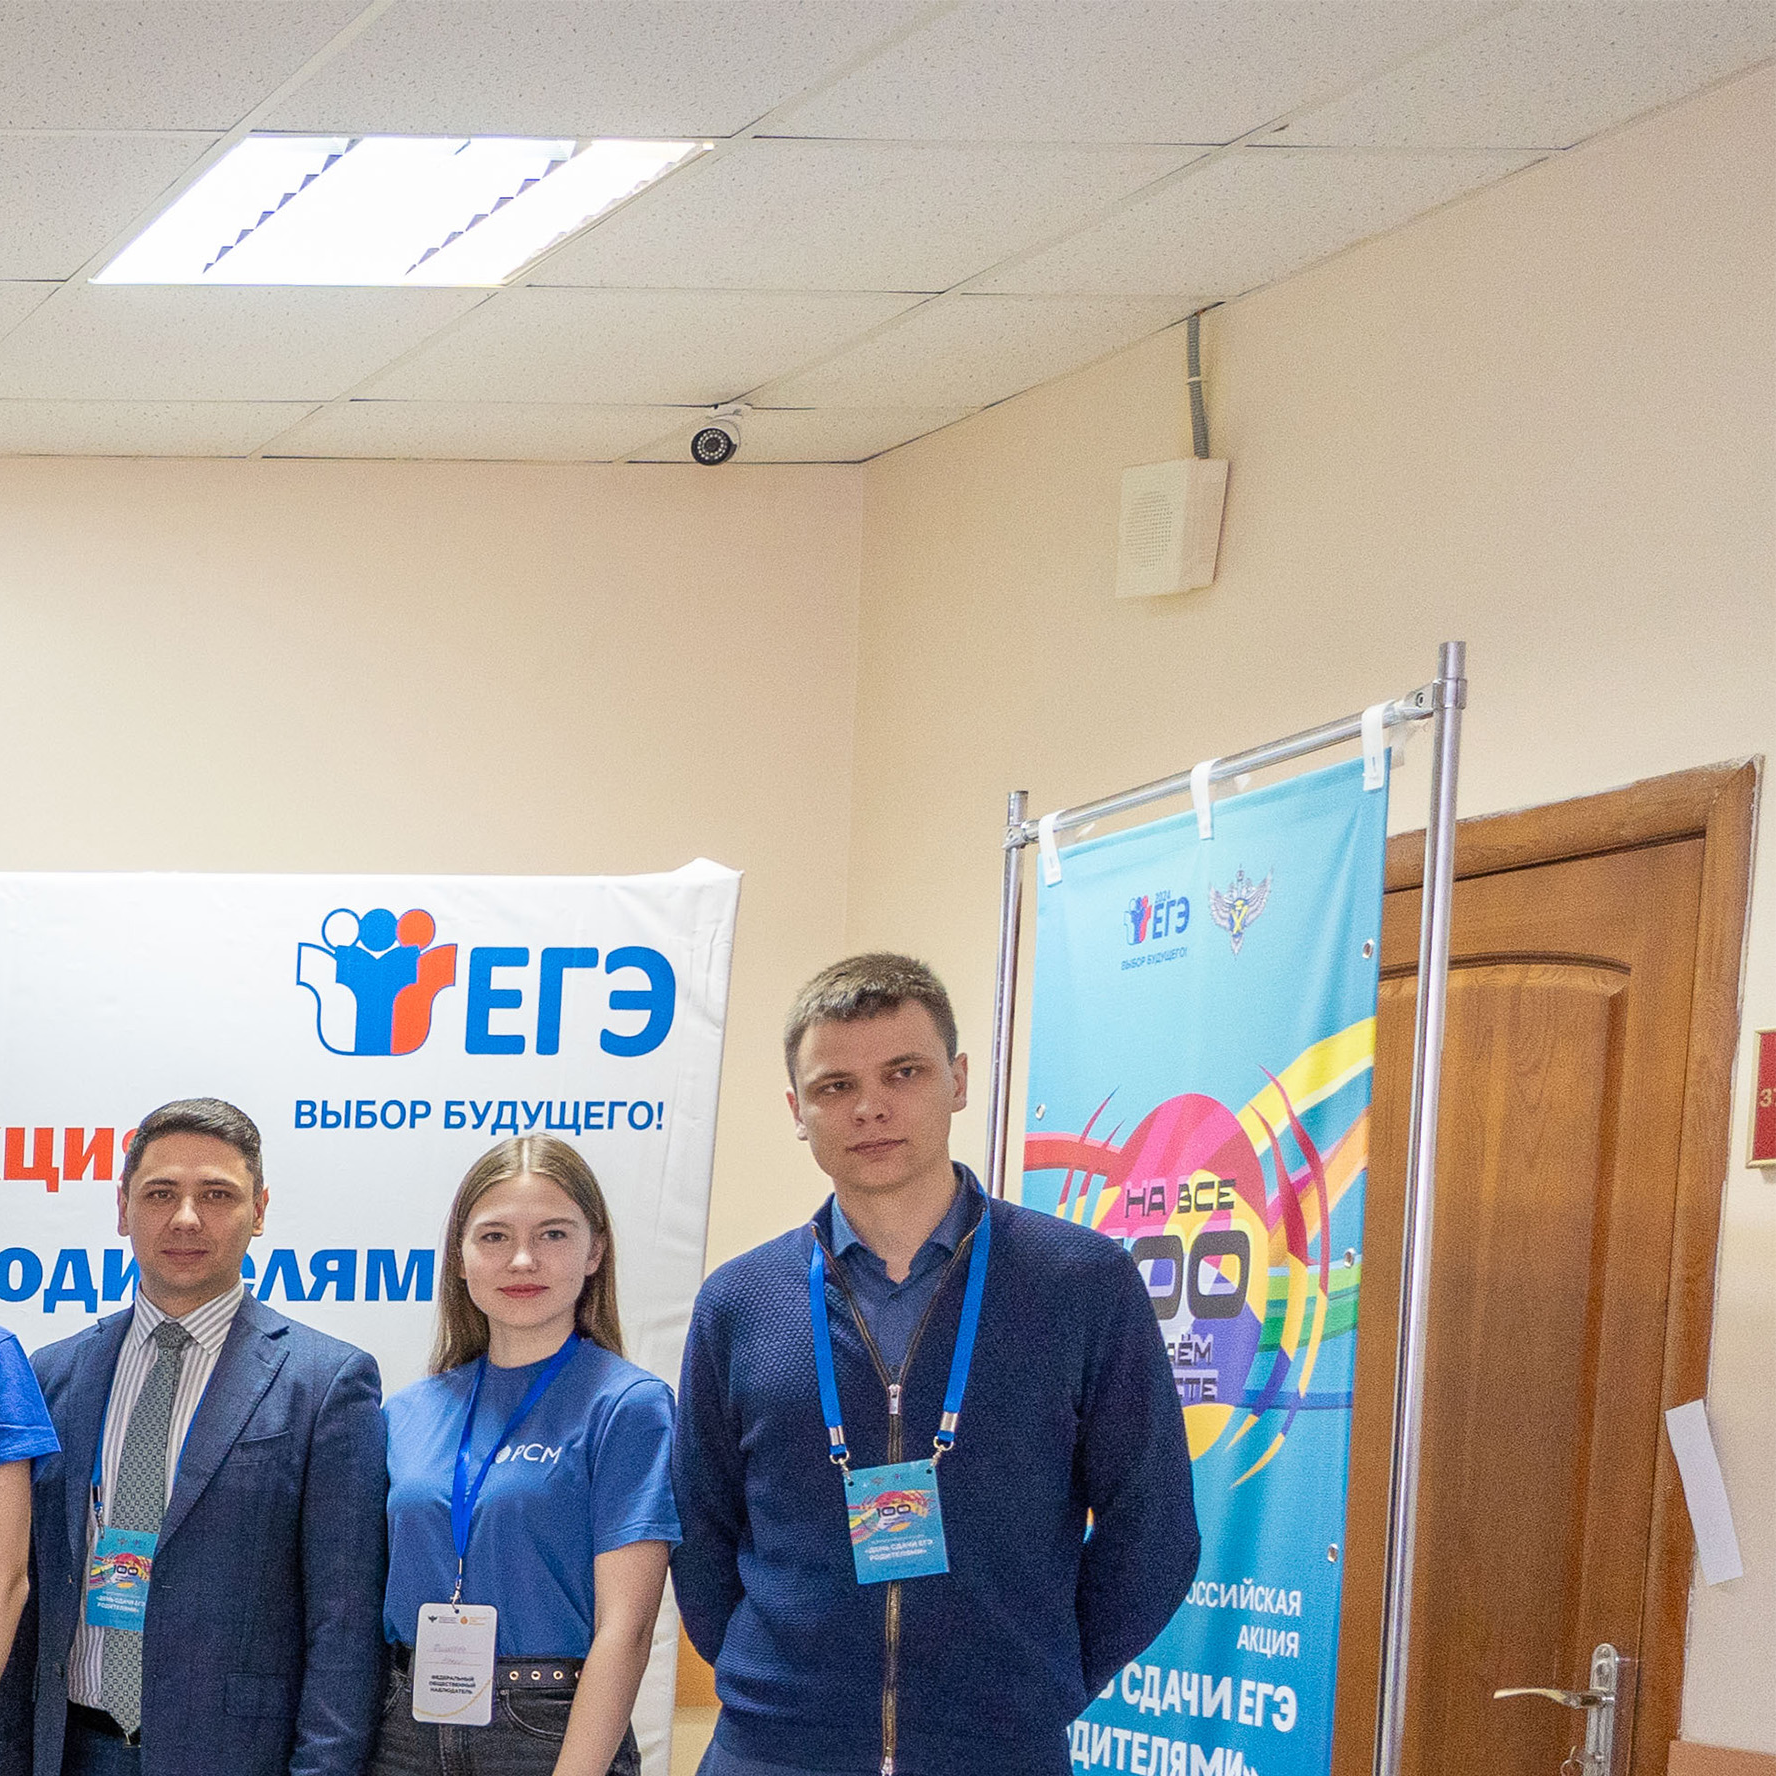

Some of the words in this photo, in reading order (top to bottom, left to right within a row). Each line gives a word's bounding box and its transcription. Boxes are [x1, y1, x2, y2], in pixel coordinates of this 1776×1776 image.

[1152, 896, 1190, 940] ЕГЭ
[465, 946, 676, 1057] ЕГЭ
[294, 1100, 431, 1130] ВЫБОР
[443, 1101, 664, 1136] БУДУЩЕГО!
[1125, 1186, 1167, 1218] НА
[1177, 1179, 1237, 1214] ВСЕ
[1112, 1230, 1251, 1320] 00
[1237, 1625, 1300, 1658] АКЦИЯ
[1121, 1662, 1232, 1721] СДАЧИ
[1238, 1679, 1297, 1732] ЕГЭ
